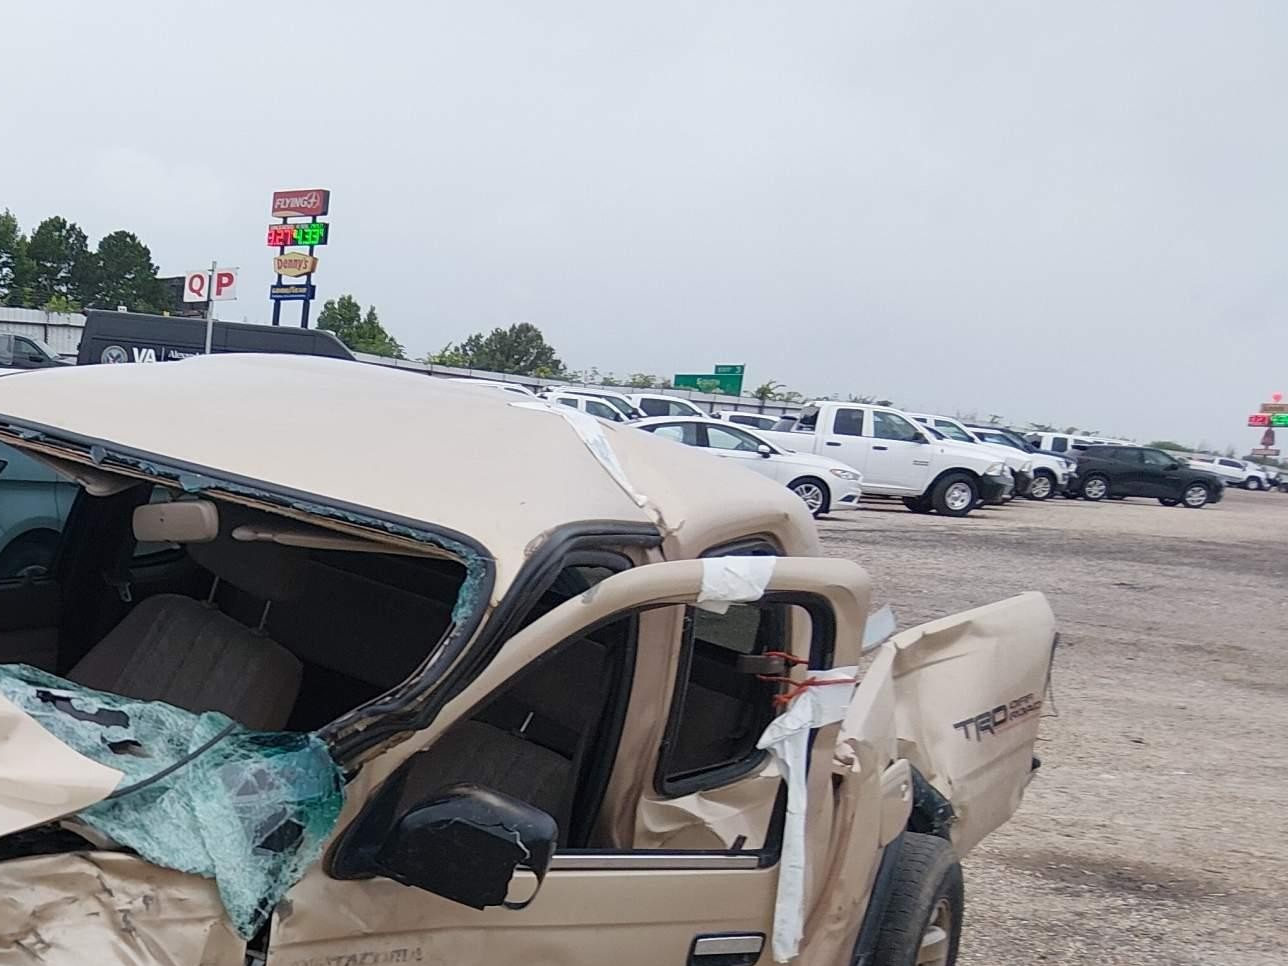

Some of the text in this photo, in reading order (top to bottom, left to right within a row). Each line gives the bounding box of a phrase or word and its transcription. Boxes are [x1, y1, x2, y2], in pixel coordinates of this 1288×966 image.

[277, 257, 309, 271] Denny's
[188, 273, 204, 297] Q
[215, 272, 234, 296] P
[132, 347, 157, 363] VA
[952, 704, 1009, 742] TRD
